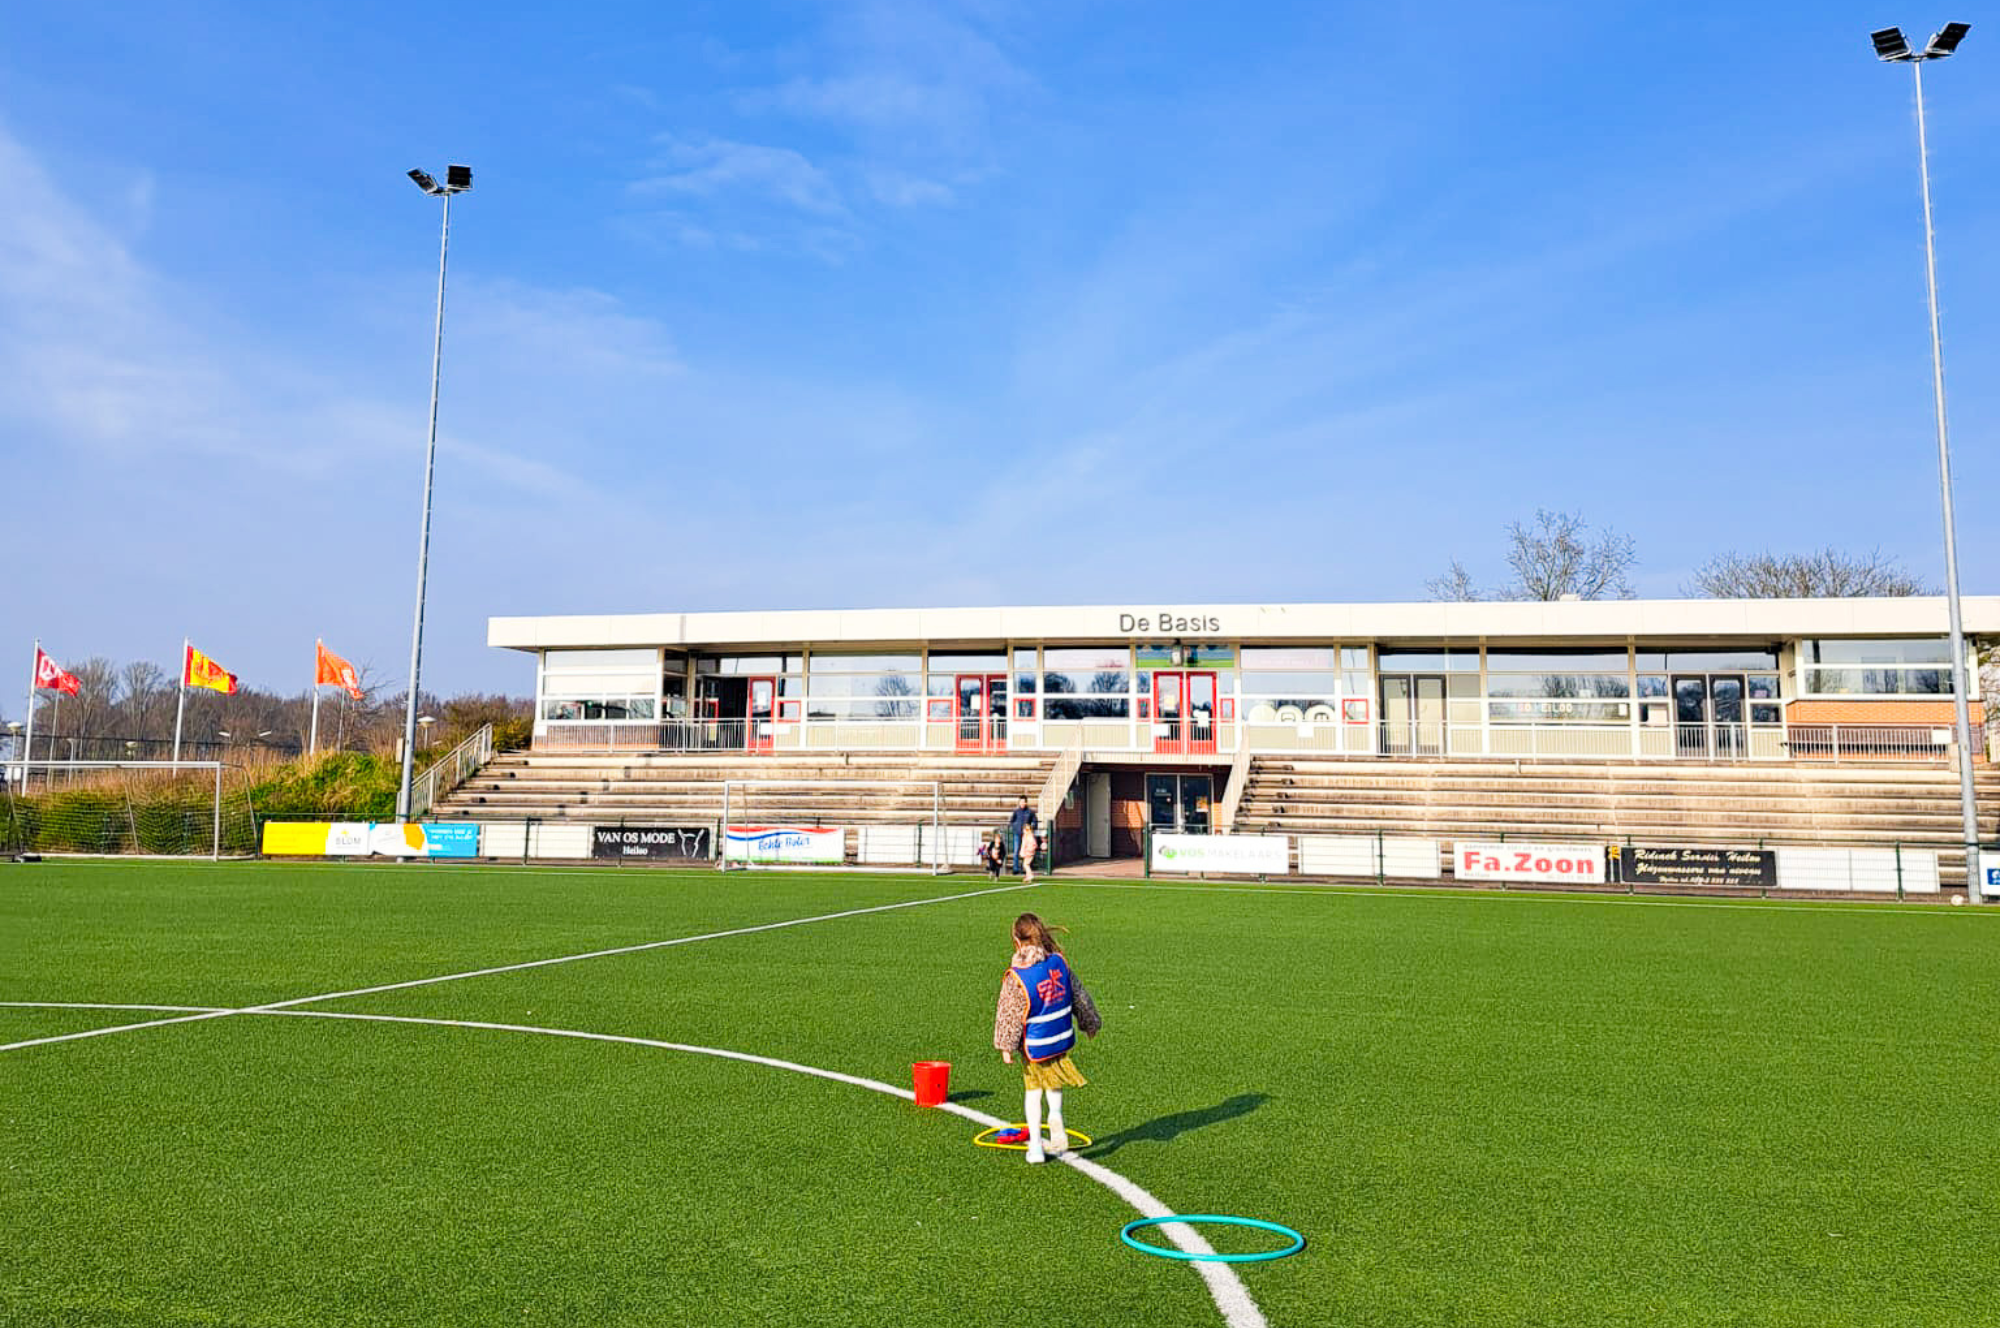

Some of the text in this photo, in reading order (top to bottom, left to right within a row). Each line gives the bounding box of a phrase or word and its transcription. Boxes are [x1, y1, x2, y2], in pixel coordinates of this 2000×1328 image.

[1119, 613, 1220, 632] De Basis
[597, 831, 676, 844] VAN OS MODE
[1179, 847, 1282, 860] VOS MAKELAARS
